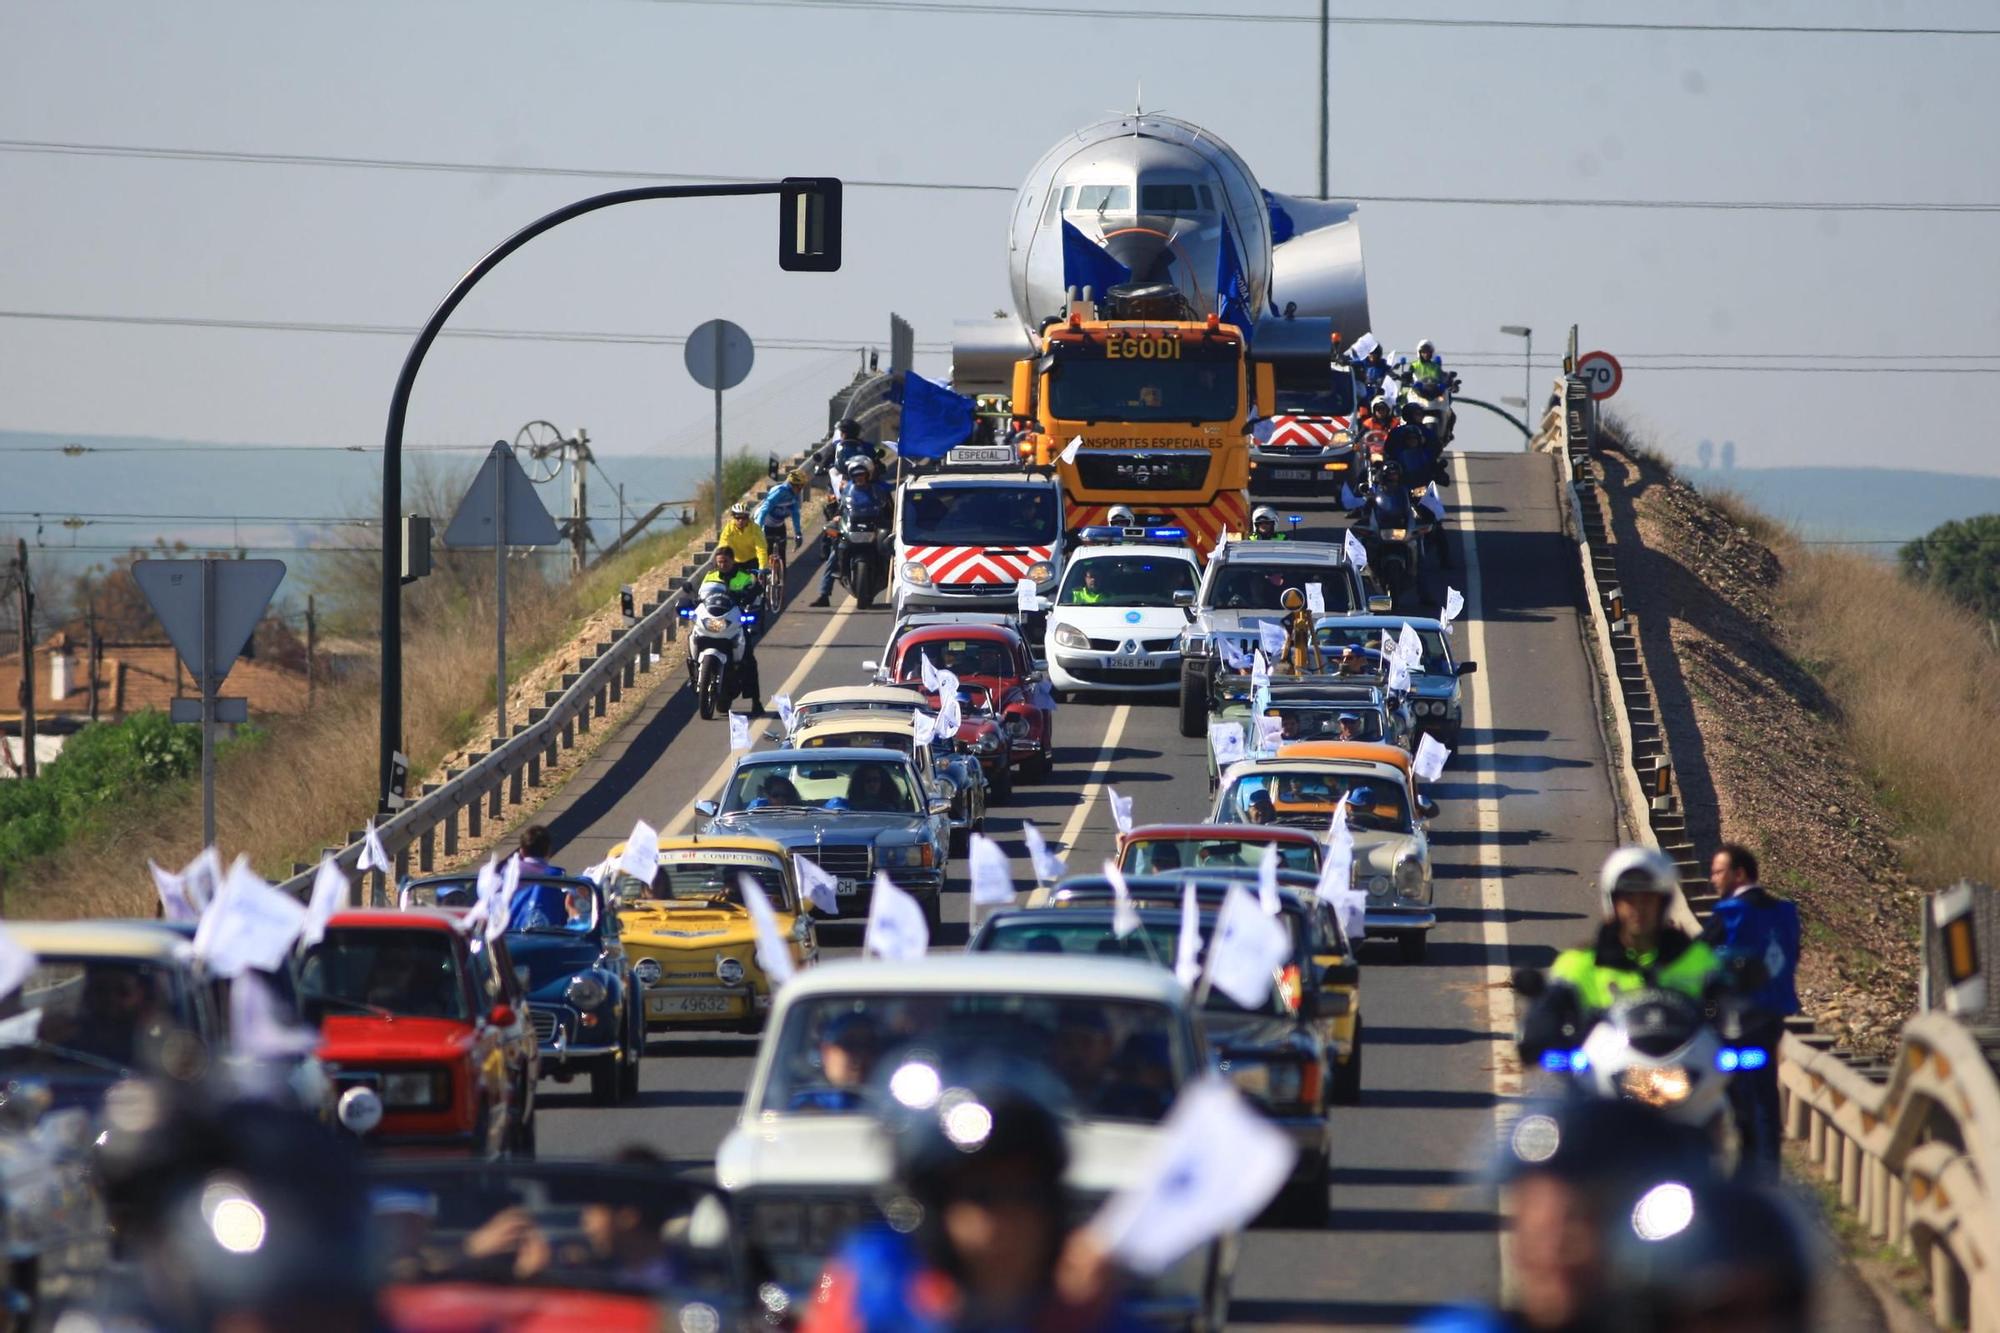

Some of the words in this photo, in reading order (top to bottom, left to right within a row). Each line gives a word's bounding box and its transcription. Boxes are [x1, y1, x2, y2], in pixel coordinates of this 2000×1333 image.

[1106, 338, 1181, 359] EGODI
[1585, 367, 1610, 384] 70
[1064, 437, 1149, 449] TANSPORTES
[1152, 437, 1223, 449] ESPECIALES
[958, 450, 999, 460] ESPECIAL
[1117, 465, 1168, 475] MAN
